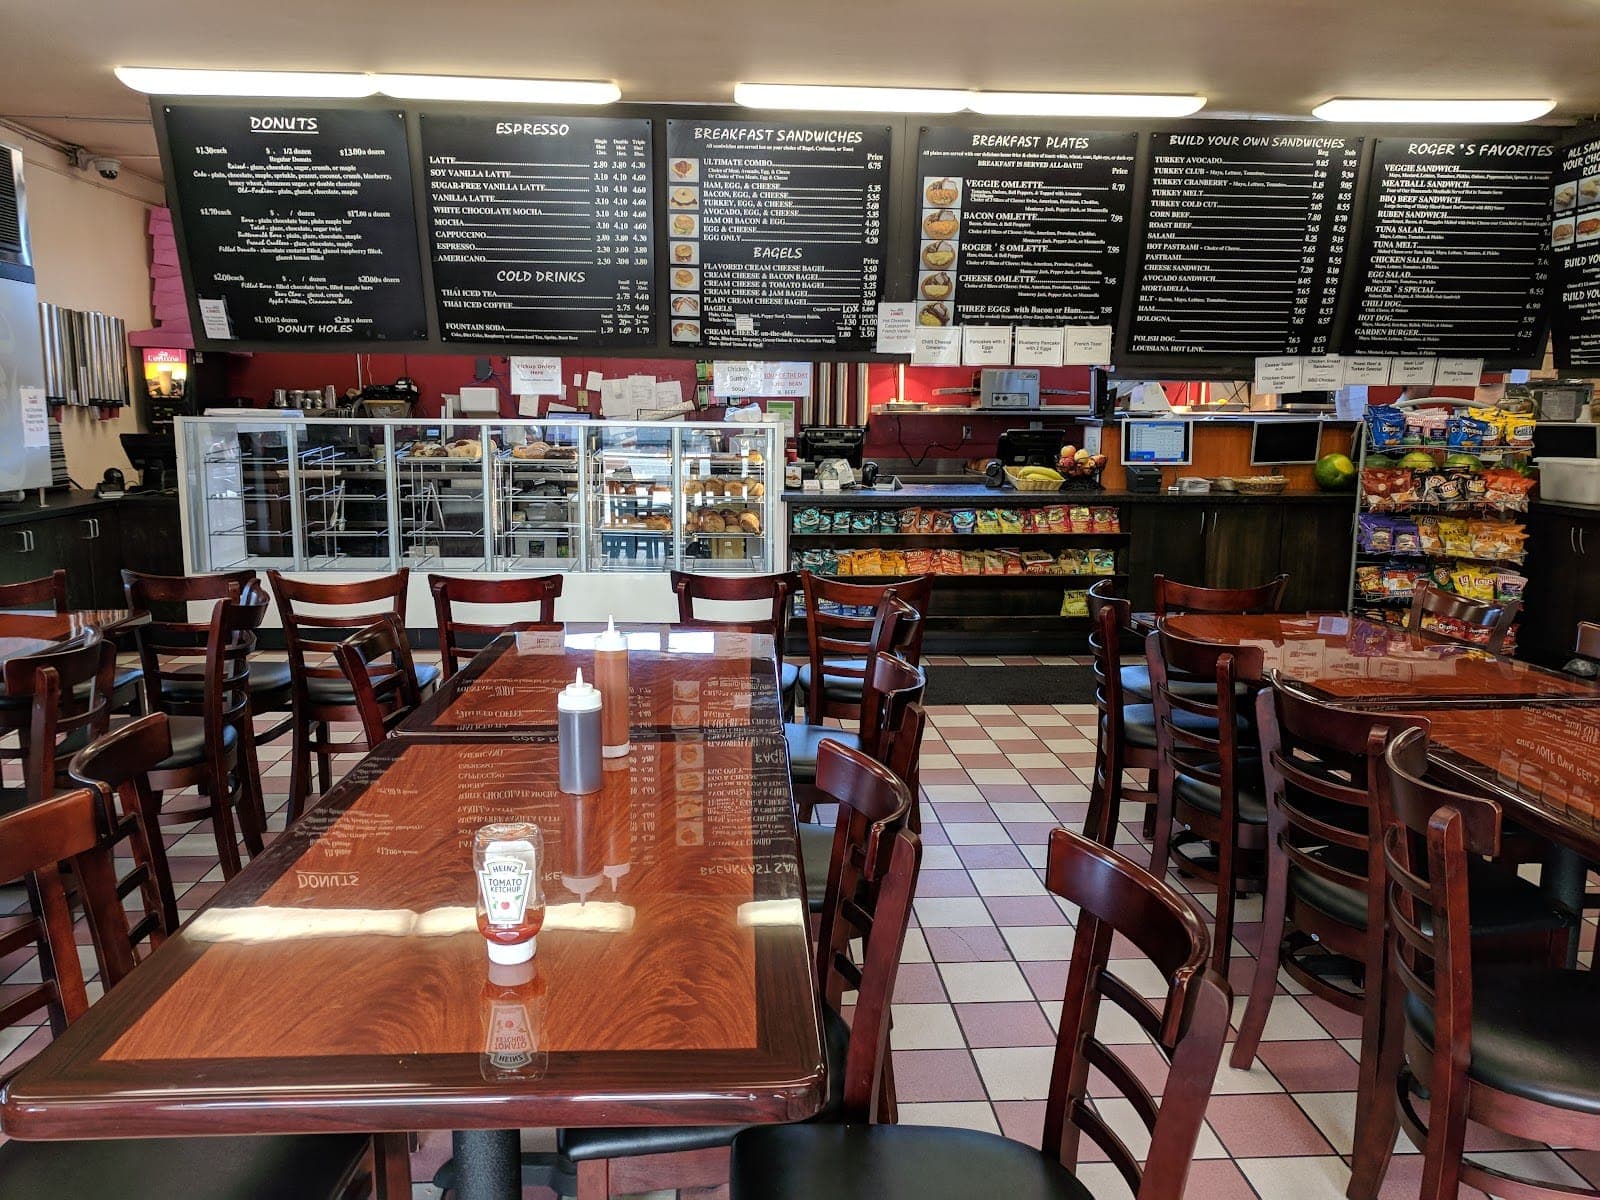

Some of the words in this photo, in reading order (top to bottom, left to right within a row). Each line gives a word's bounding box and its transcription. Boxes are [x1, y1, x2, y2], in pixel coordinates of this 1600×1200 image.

[250, 117, 318, 130] DONUTS
[496, 122, 569, 136] ESPRESSO
[694, 128, 774, 141] BREAKFAST
[776, 129, 863, 144] SANDWICHES
[972, 134, 1041, 148] BREAKFAST
[1046, 137, 1089, 149] PLATES
[1169, 135, 1204, 147] BUILD
[1207, 137, 1239, 148] YOUR
[1242, 137, 1269, 148] OWN
[1271, 138, 1346, 150] SANDWICHES
[1408, 143, 1455, 156] ROGER
[1479, 144, 1554, 157] FAVORITES
[1568, 145, 1581, 159] ALL
[429, 156, 456, 164] LATTE
[703, 158, 743, 166] ULTIMATE
[744, 160, 773, 168] COMBO
[1155, 156, 1184, 164] TURKEY
[1185, 157, 1223, 165] AVOCADO
[1563, 157, 1583, 171] YOUR
[1154, 167, 1182, 175] TURKEY
[1385, 164, 1415, 172] VEGGIE
[1416, 164, 1460, 173] SANDWICH
[430, 169, 446, 177] SOY
[447, 169, 484, 178] VANILLA
[485, 170, 512, 178] LATTE
[431, 181, 481, 190] SUGAR-FREE
[482, 182, 518, 191] VANILLA
[519, 183, 546, 192] LATTE
[751, 183, 780, 191] CHEESE
[966, 180, 1000, 189] VEGGIE
[1001, 181, 1044, 190] OMLETTE
[1152, 178, 1182, 186] TURKEY
[1183, 179, 1228, 188] CRANBERRY
[1381, 179, 1425, 188] MEATBALL
[1427, 180, 1470, 189] SANDWICH
[432, 193, 467, 202] VANILLA
[469, 194, 496, 202] LATTE
[1152, 189, 1181, 197] TURKEY
[1182, 190, 1203, 198] MELT
[1379, 195, 1396, 204] BBQ
[1397, 195, 1417, 204] BEEF
[1418, 196, 1461, 204] SANDWICH
[764, 201, 794, 209] CHEESE
[1151, 200, 1180, 208] TURKEY
[1181, 200, 1202, 209] COLD
[433, 206, 460, 215] WHITE
[461, 207, 512, 216] CHOCOLATE
[513, 207, 543, 217] MOCHA
[1150, 211, 1171, 219] CORN
[1377, 210, 1403, 219] RUBEN
[1404, 211, 1448, 219] SANDWICH
[963, 212, 993, 221] BACON
[995, 212, 1038, 222] OMLETTE
[434, 218, 464, 227] MOCHA
[1375, 225, 1397, 234] TUNA
[1398, 226, 1424, 234] SALAD
[435, 231, 487, 240] CAPPUCCINO
[436, 242, 476, 252] ESPRESSO
[1373, 240, 1394, 248] TUNA
[753, 247, 803, 260] BAGELS
[438, 254, 486, 263] AMERICANO
[1370, 256, 1405, 264] CHICKEN
[1564, 257, 1586, 270] BUILD
[497, 270, 532, 282] COLD
[535, 271, 586, 283] DRINKS
[959, 275, 992, 283] CHEESE
[994, 276, 1036, 284] OMLETTE
[1367, 271, 1384, 279] EGG
[1385, 271, 1411, 279] SALAD
[441, 289, 461, 298] THAI
[462, 290, 480, 299] ICED
[482, 290, 498, 299] TEA
[1562, 291, 1585, 303] BUILD
[443, 300, 462, 309] THAI
[463, 301, 481, 310] ICED
[842, 305, 860, 314] LOX
[957, 305, 986, 313] THREE
[988, 305, 1010, 314] EGGS
[1014, 306, 1030, 314] with
[1031, 306, 1053, 314] Bacon
[1358, 314, 1374, 322] HOT
[277, 325, 315, 333] DONUT
[318, 325, 353, 333] HOLES
[445, 323, 483, 332] FOUNTAIN
[1354, 329, 1386, 337] GARDEN
[492, 864, 518, 873] HEINZ
[489, 878, 522, 887] TOMATO
